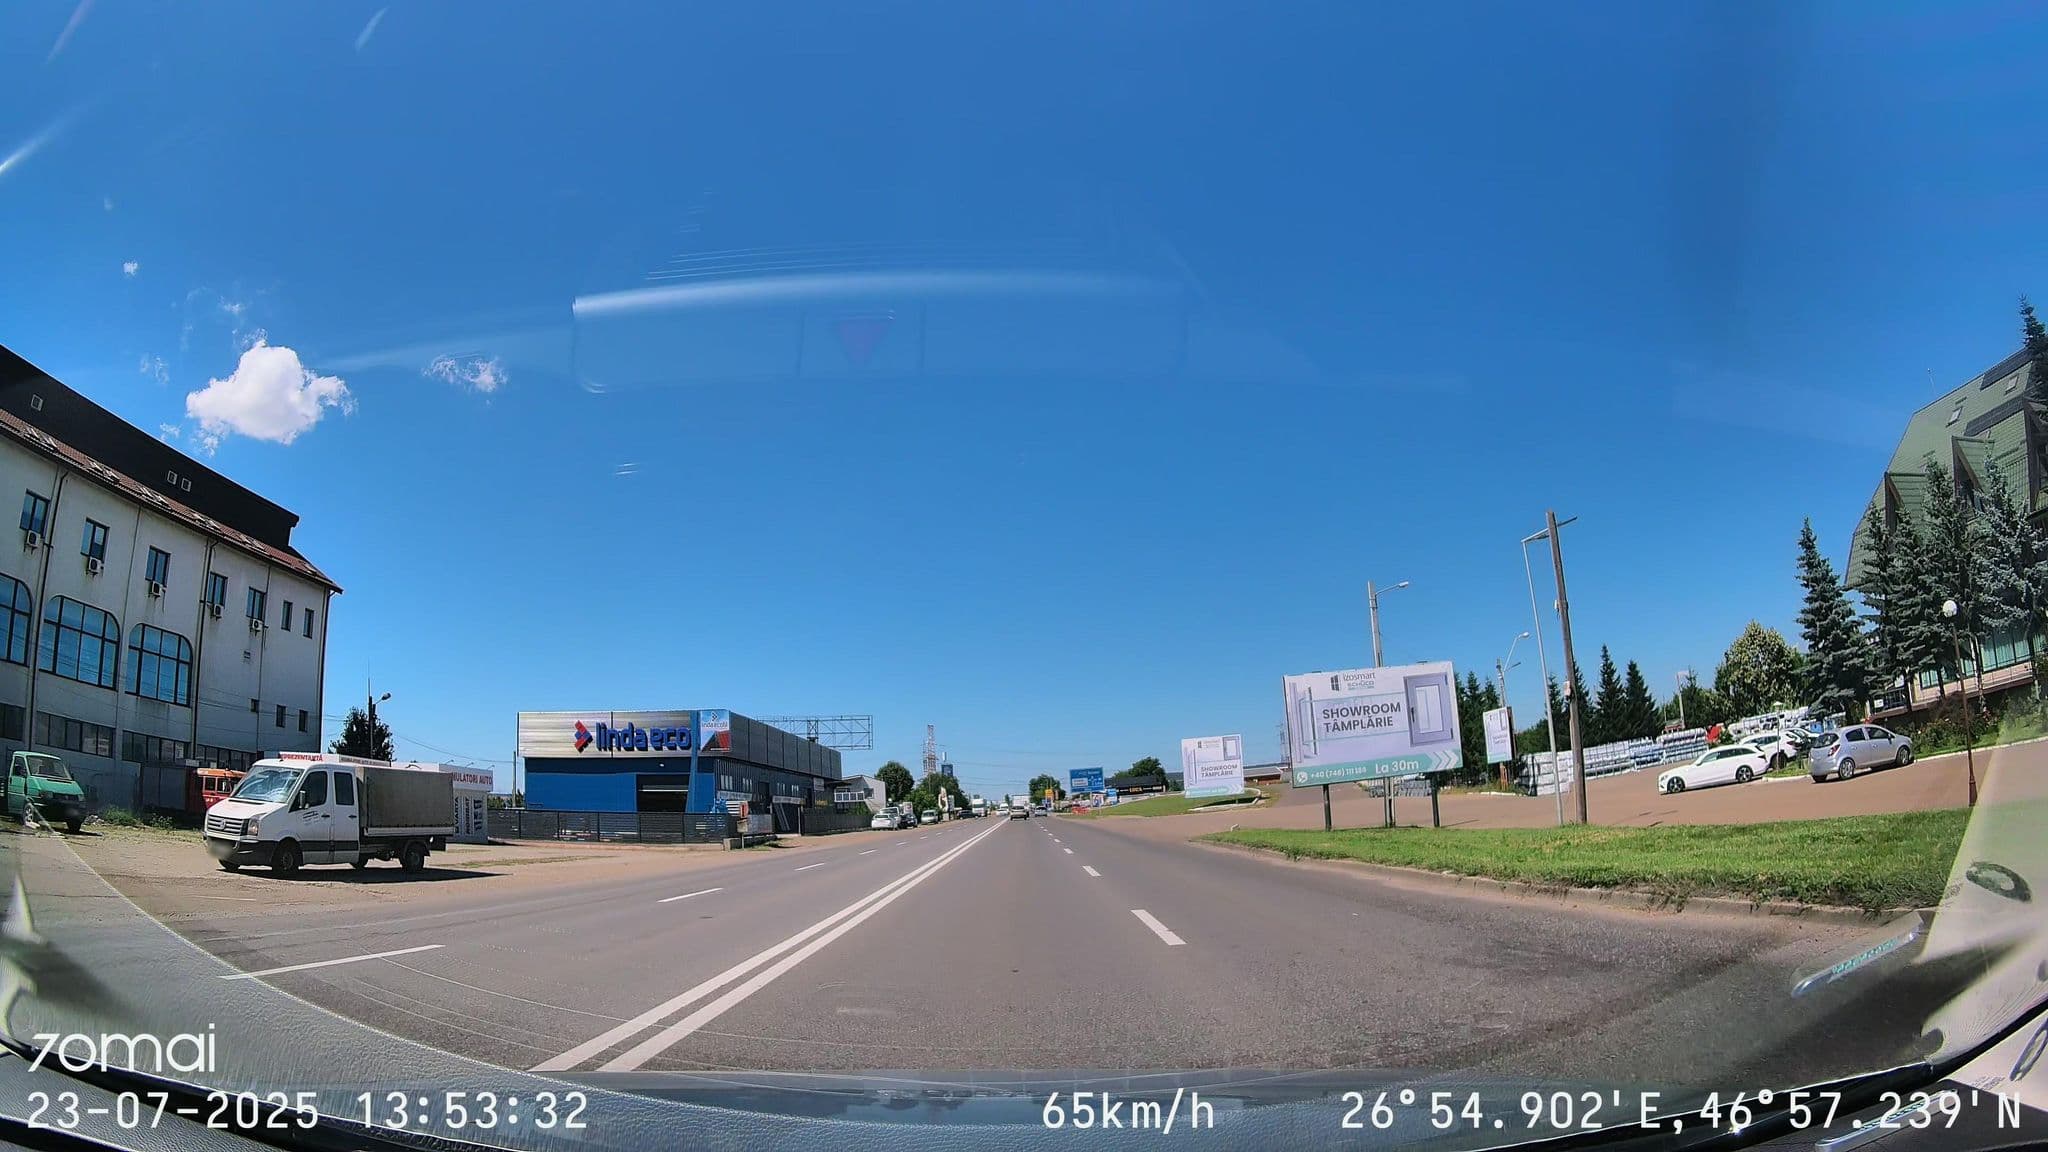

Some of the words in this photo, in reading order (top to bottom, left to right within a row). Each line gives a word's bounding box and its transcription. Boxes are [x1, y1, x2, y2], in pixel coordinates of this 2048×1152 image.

[1322, 702, 1401, 719] SHOWROOM
[1323, 714, 1393, 733] TÂMPLĂRIE
[596, 721, 648, 751] linda
[1375, 763, 1388, 774] La
[1392, 759, 1419, 771] 30m
